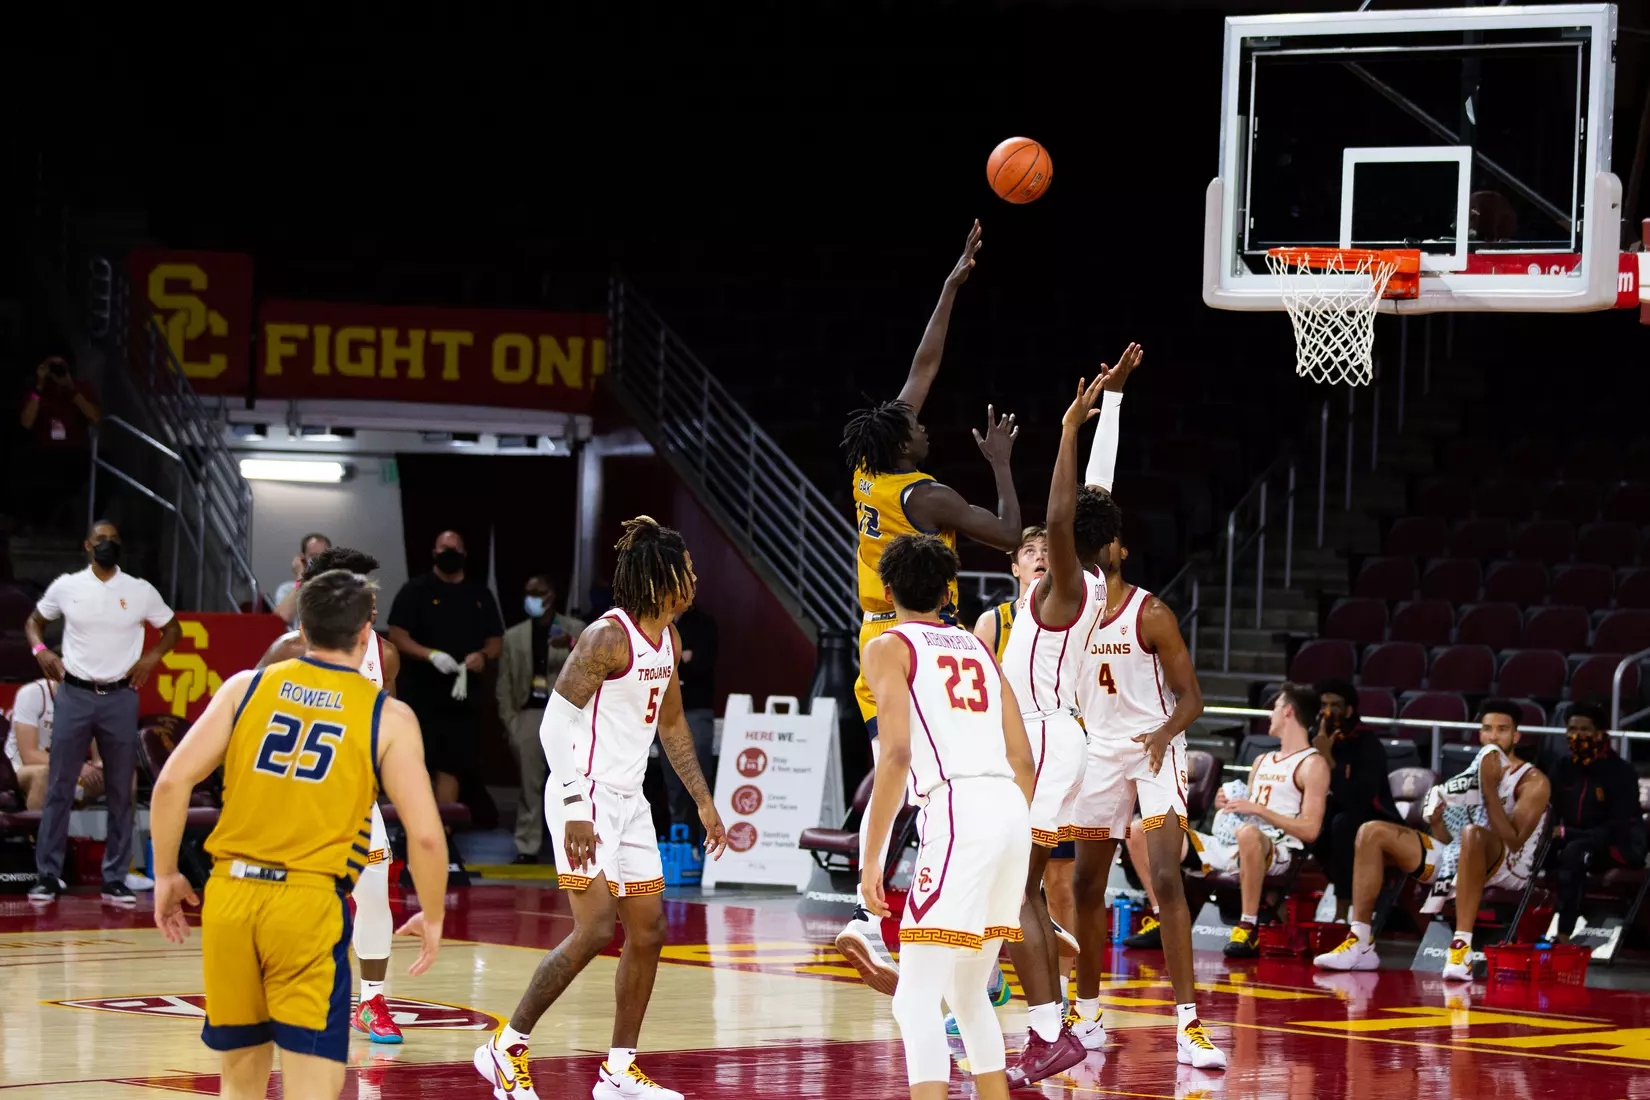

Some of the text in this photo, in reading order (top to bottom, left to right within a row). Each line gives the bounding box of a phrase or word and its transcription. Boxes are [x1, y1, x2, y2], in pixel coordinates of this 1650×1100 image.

[264, 322, 474, 381] FIGHT
[1091, 643, 1131, 655] OJANS
[638, 666, 672, 681] TROJANS
[937, 654, 989, 713] 23
[1098, 662, 1118, 694] 4
[279, 680, 345, 711] ROWELL
[644, 686, 660, 725] 5
[253, 710, 348, 784] 25
[745, 731, 774, 742] HERE
[777, 732, 795, 743] WE
[1192, 924, 1233, 938] POWER
